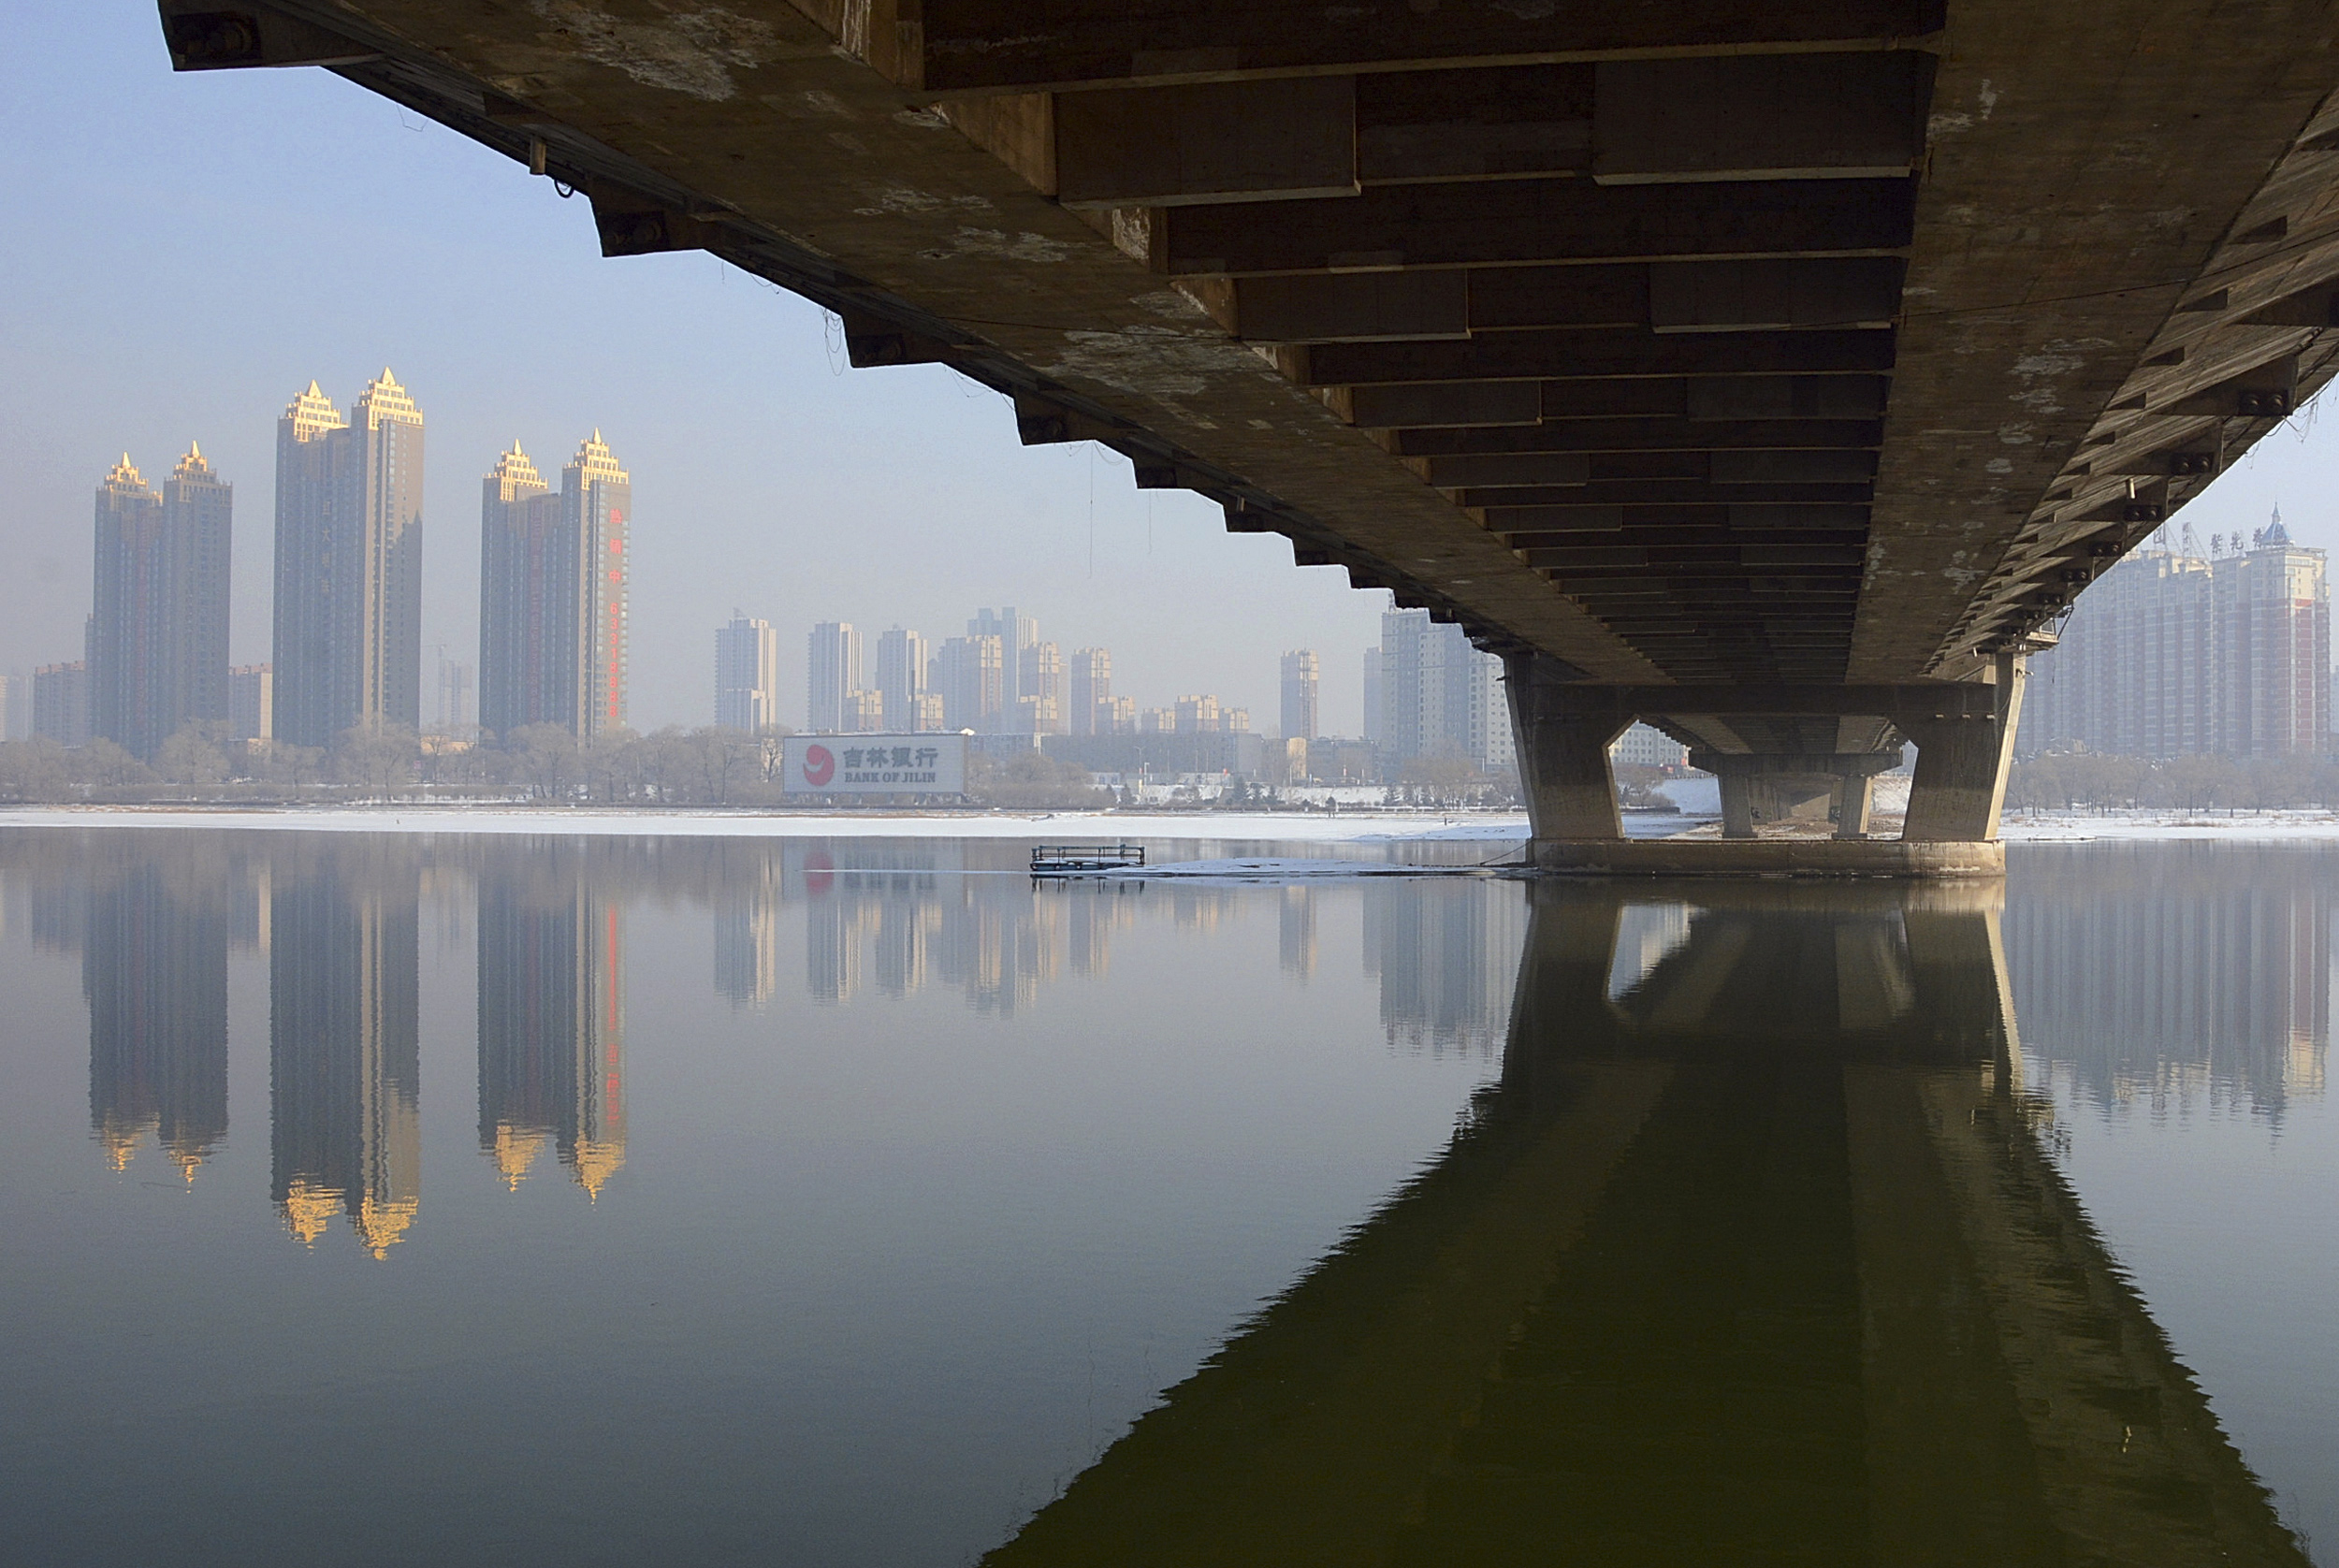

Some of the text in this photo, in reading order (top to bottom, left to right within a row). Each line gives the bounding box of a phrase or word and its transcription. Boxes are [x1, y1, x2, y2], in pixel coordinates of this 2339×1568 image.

[609, 602, 618, 718] 63318888
[845, 772, 936, 783] BANK OF JILIN
